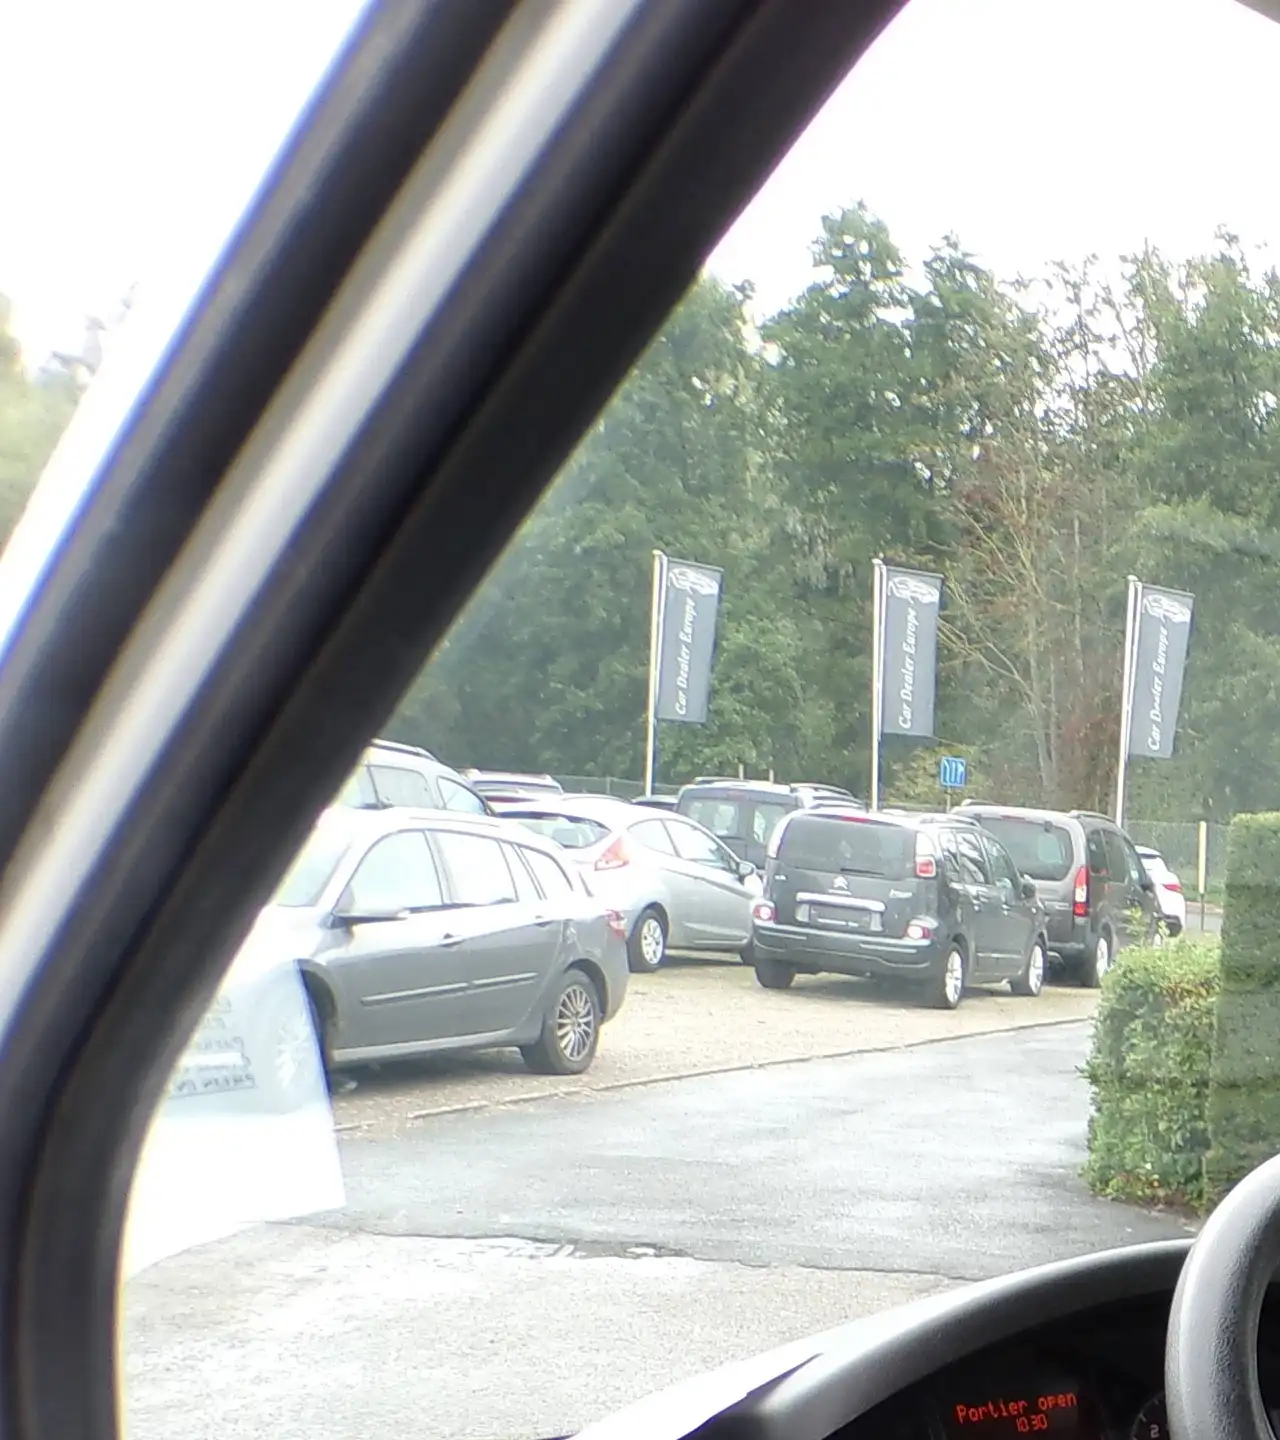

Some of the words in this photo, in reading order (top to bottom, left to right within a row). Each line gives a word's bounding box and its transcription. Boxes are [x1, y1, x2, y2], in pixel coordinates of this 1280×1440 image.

[679, 597, 697, 643] Europe
[902, 607, 919, 654] Europe
[676, 645, 690, 688] Dealer
[1152, 625, 1169, 674] Europe
[901, 656, 914, 701] Dealer
[1150, 676, 1164, 722] Dealer
[676, 691, 687, 715] Car
[899, 703, 911, 729] Car
[1148, 725, 1161, 751] Car
[1037, 1392, 1078, 1411] open
[1150, 1424, 1160, 1439] 2
